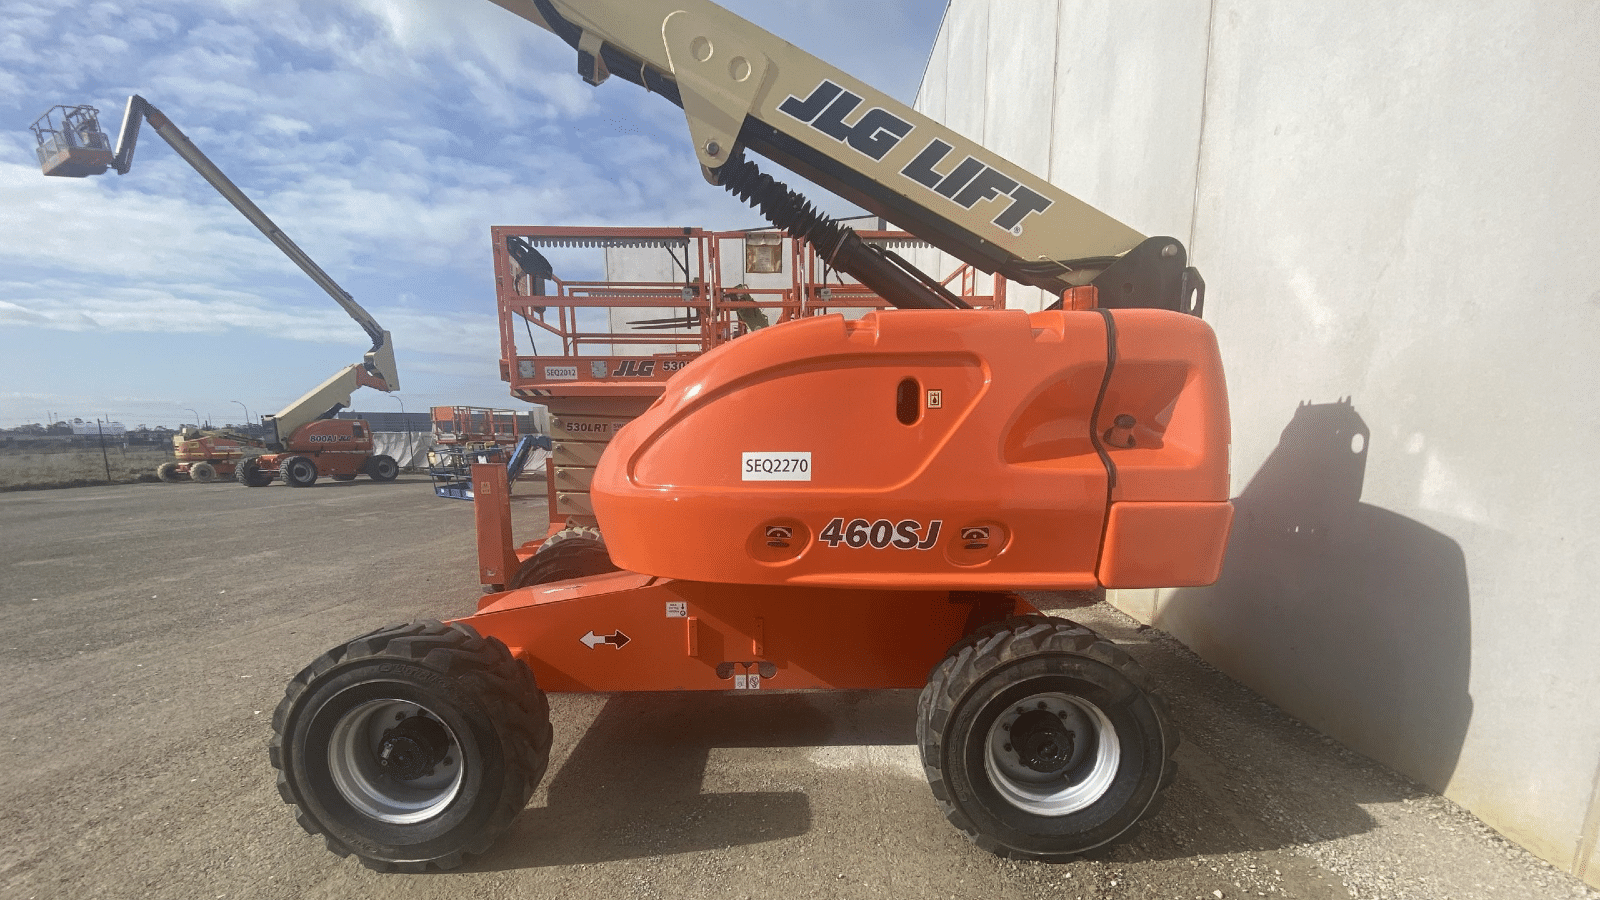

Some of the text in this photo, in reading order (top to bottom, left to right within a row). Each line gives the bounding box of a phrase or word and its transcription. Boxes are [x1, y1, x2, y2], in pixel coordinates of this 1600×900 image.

[776, 79, 1053, 233] JLG LIFT
[546, 368, 577, 377] SEQ2012
[612, 360, 690, 378] JLG 530
[566, 422, 609, 433] 530LRT
[309, 434, 337, 443] 800AJ
[745, 458, 809, 473] SEQ2270
[819, 517, 943, 551] 460SJ
